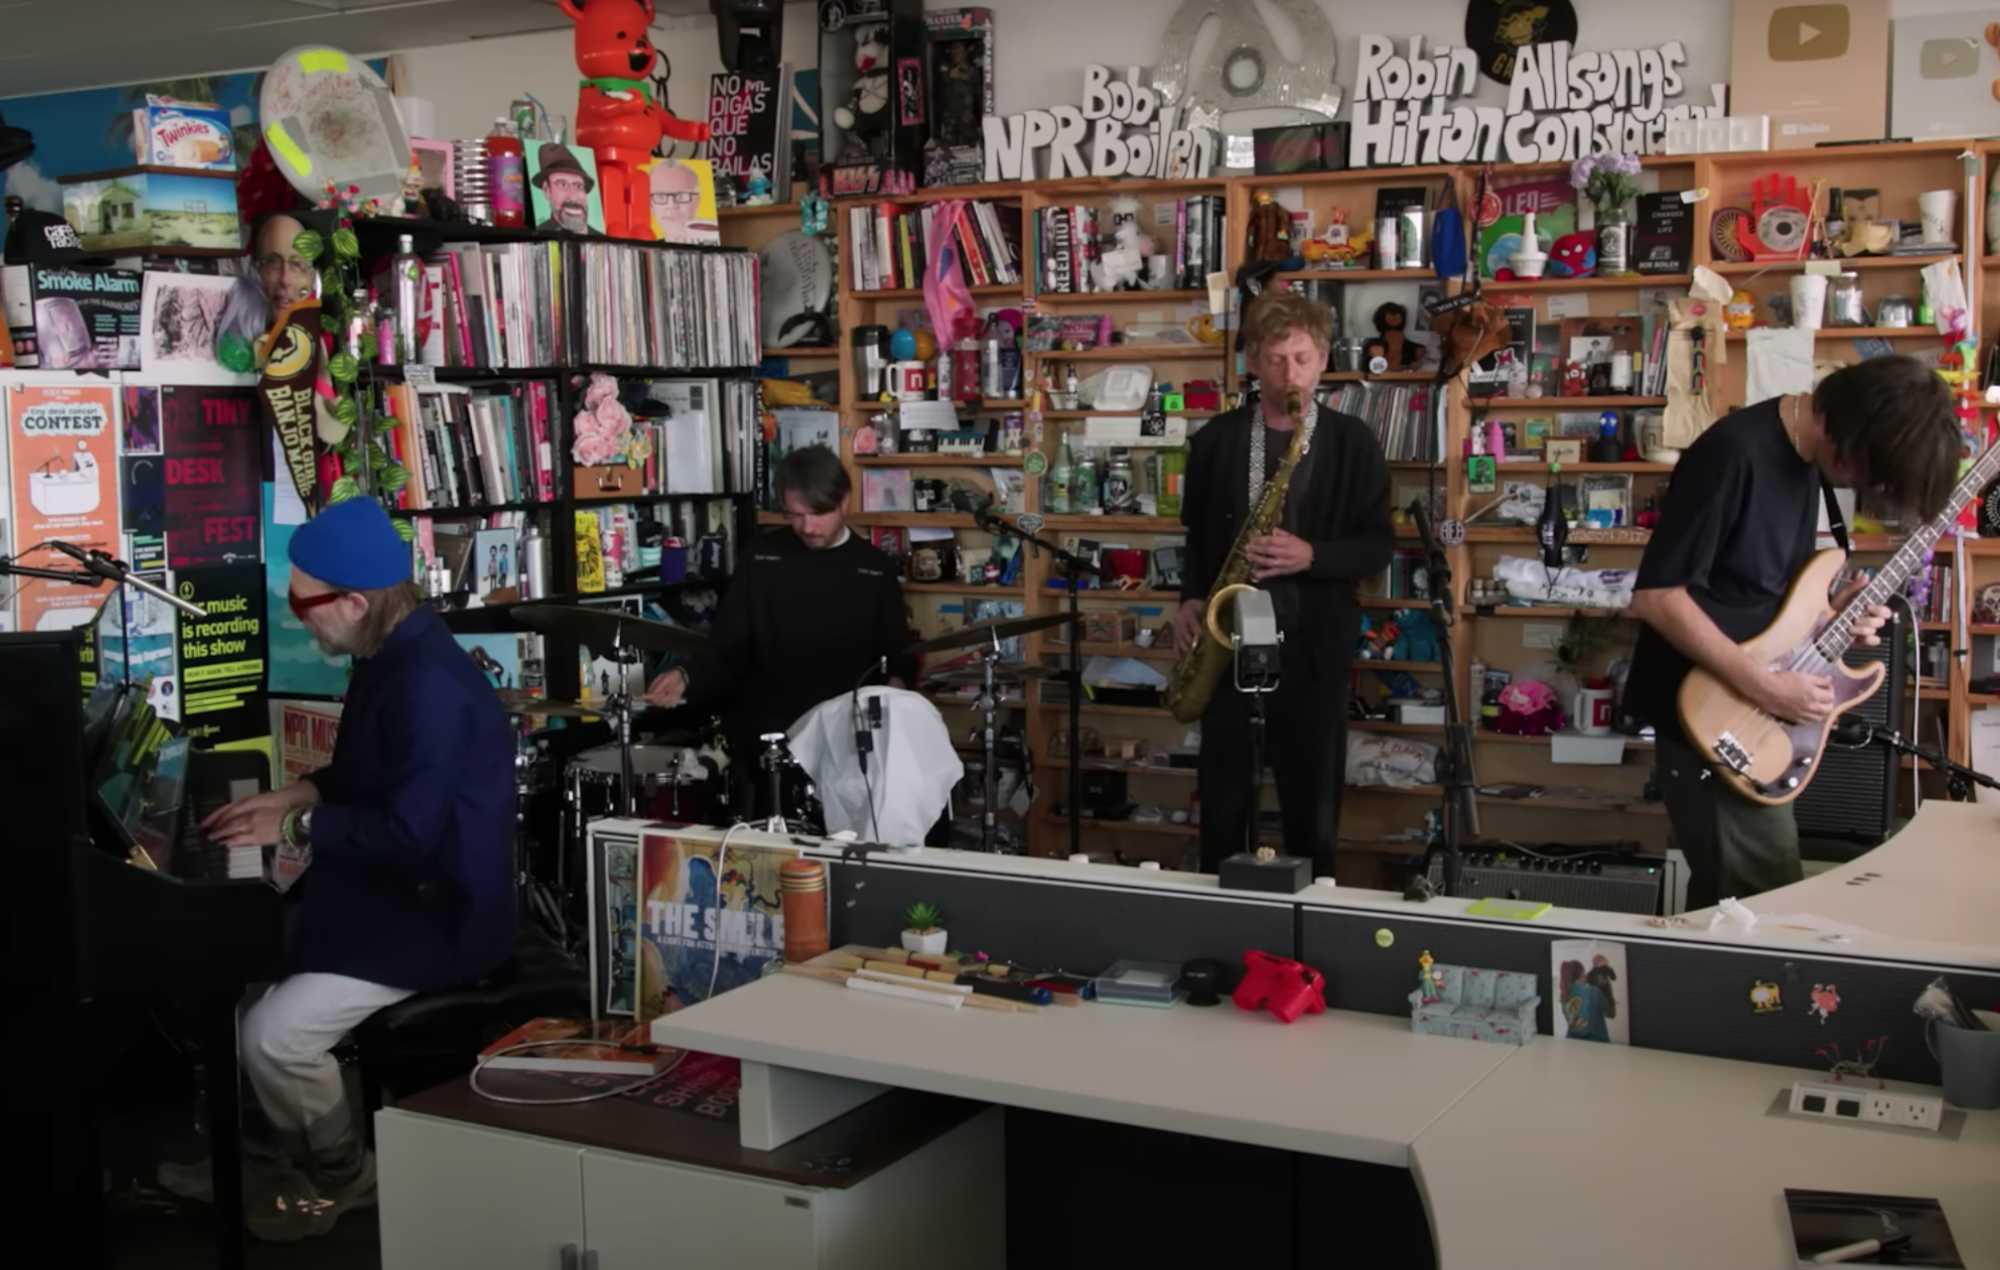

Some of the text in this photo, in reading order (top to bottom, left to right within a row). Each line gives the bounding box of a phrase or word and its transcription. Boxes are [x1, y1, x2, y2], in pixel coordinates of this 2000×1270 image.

[713, 75, 741, 96] NO
[1353, 34, 1688, 122] Robin Allsongs
[711, 93, 766, 116] DIGAS
[1084, 63, 1155, 126] Bob
[157, 122, 210, 148] Twinkies
[709, 114, 748, 136] QUE
[1349, 98, 1505, 168] Hilton
[708, 136, 736, 157] NO
[982, 104, 1091, 182] NPR
[1091, 107, 1211, 179] Boilen
[710, 153, 772, 176] BAILAS
[37, 270, 140, 293] Smoke Alarm
[24, 415, 102, 430] CONTEST
[203, 397, 250, 425] TINY
[265, 384, 311, 498] BANJO MAGIC
[293, 386, 317, 485] BLACK GIRL
[164, 457, 224, 485] DESK
[204, 515, 256, 545] FEST
[206, 593, 248, 615] music
[182, 616, 260, 639] is recording
[183, 639, 247, 659] this show
[284, 711, 308, 748] NPR
[646, 900, 700, 938] THE
